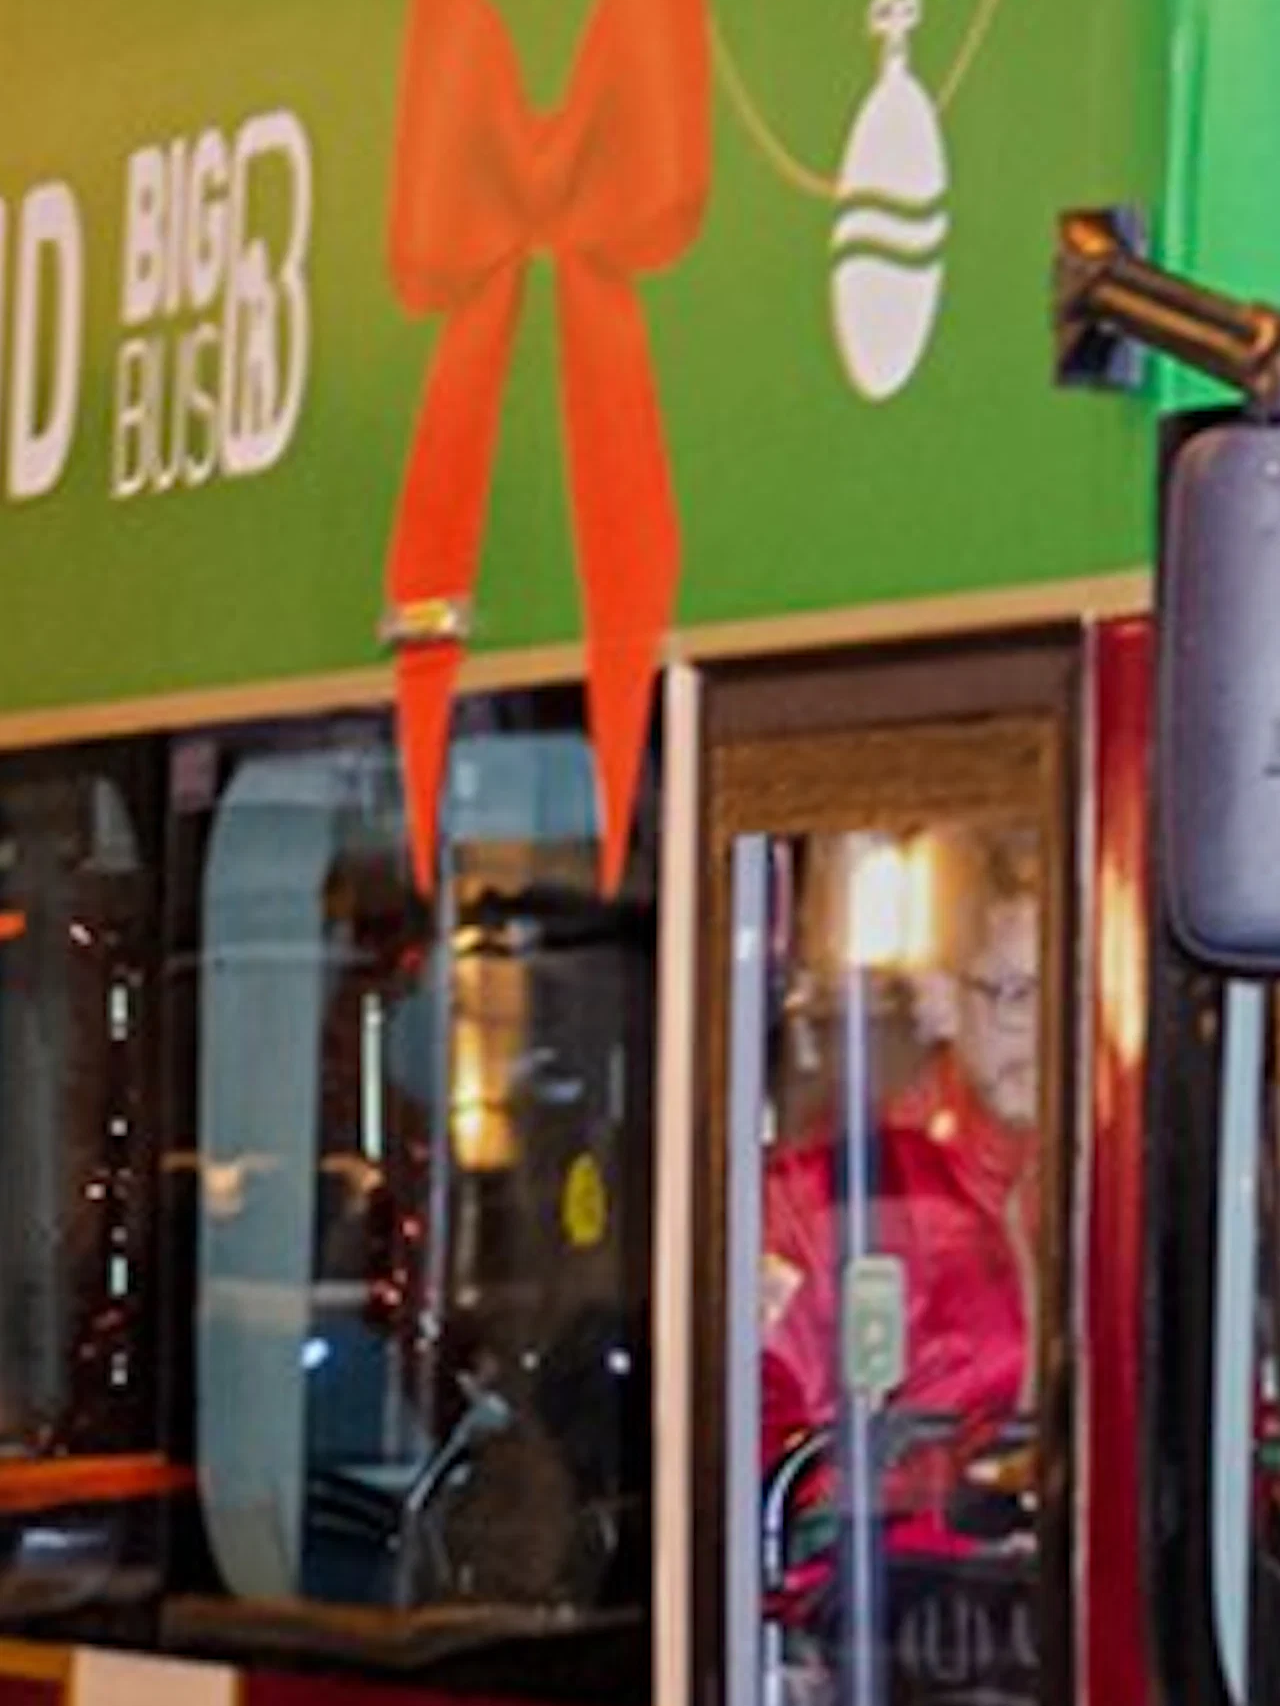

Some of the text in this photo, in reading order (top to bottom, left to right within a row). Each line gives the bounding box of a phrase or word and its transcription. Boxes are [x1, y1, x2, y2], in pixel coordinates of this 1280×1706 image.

[125, 126, 230, 321] BIG
[0, 178, 85, 502] D
[115, 326, 219, 497] BUS
